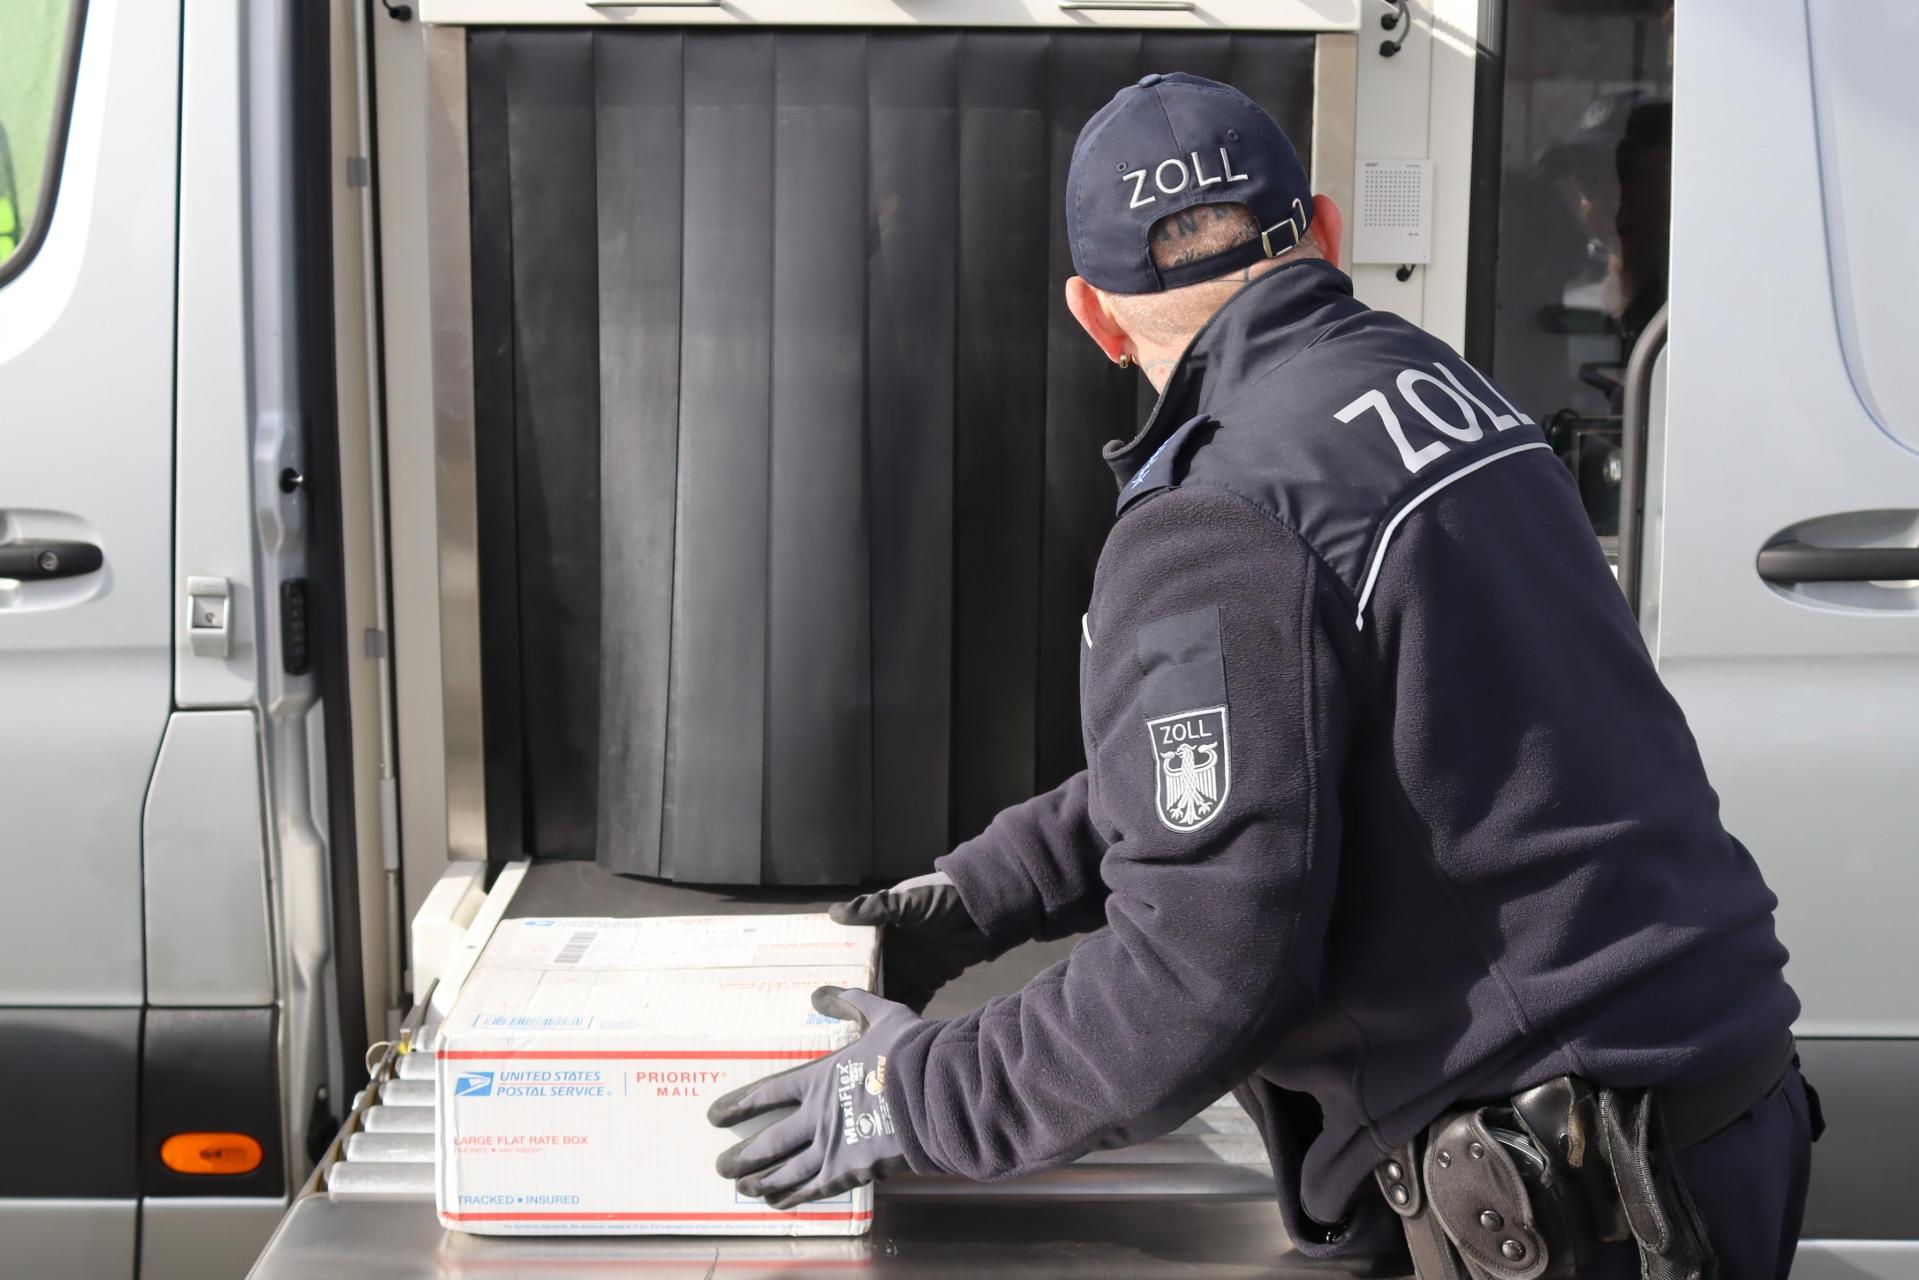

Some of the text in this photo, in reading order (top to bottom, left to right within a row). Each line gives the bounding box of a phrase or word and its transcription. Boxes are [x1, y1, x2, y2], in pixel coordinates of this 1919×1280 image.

[1122, 147, 1249, 209] ZOLL
[1333, 357, 1536, 474] ZOLL
[1160, 719, 1212, 745] ZOLL
[500, 1071, 601, 1081] UNITED STATES
[636, 1072, 720, 1083] PRIORITY
[496, 1086, 605, 1096] POSTAL SERVICE
[657, 1087, 700, 1096] MAIL
[837, 1062, 859, 1145] MaxiFlex
[453, 1136, 588, 1145] LARGE FLAT RATE BOX
[457, 1195, 580, 1205] TRACKED INSURED
